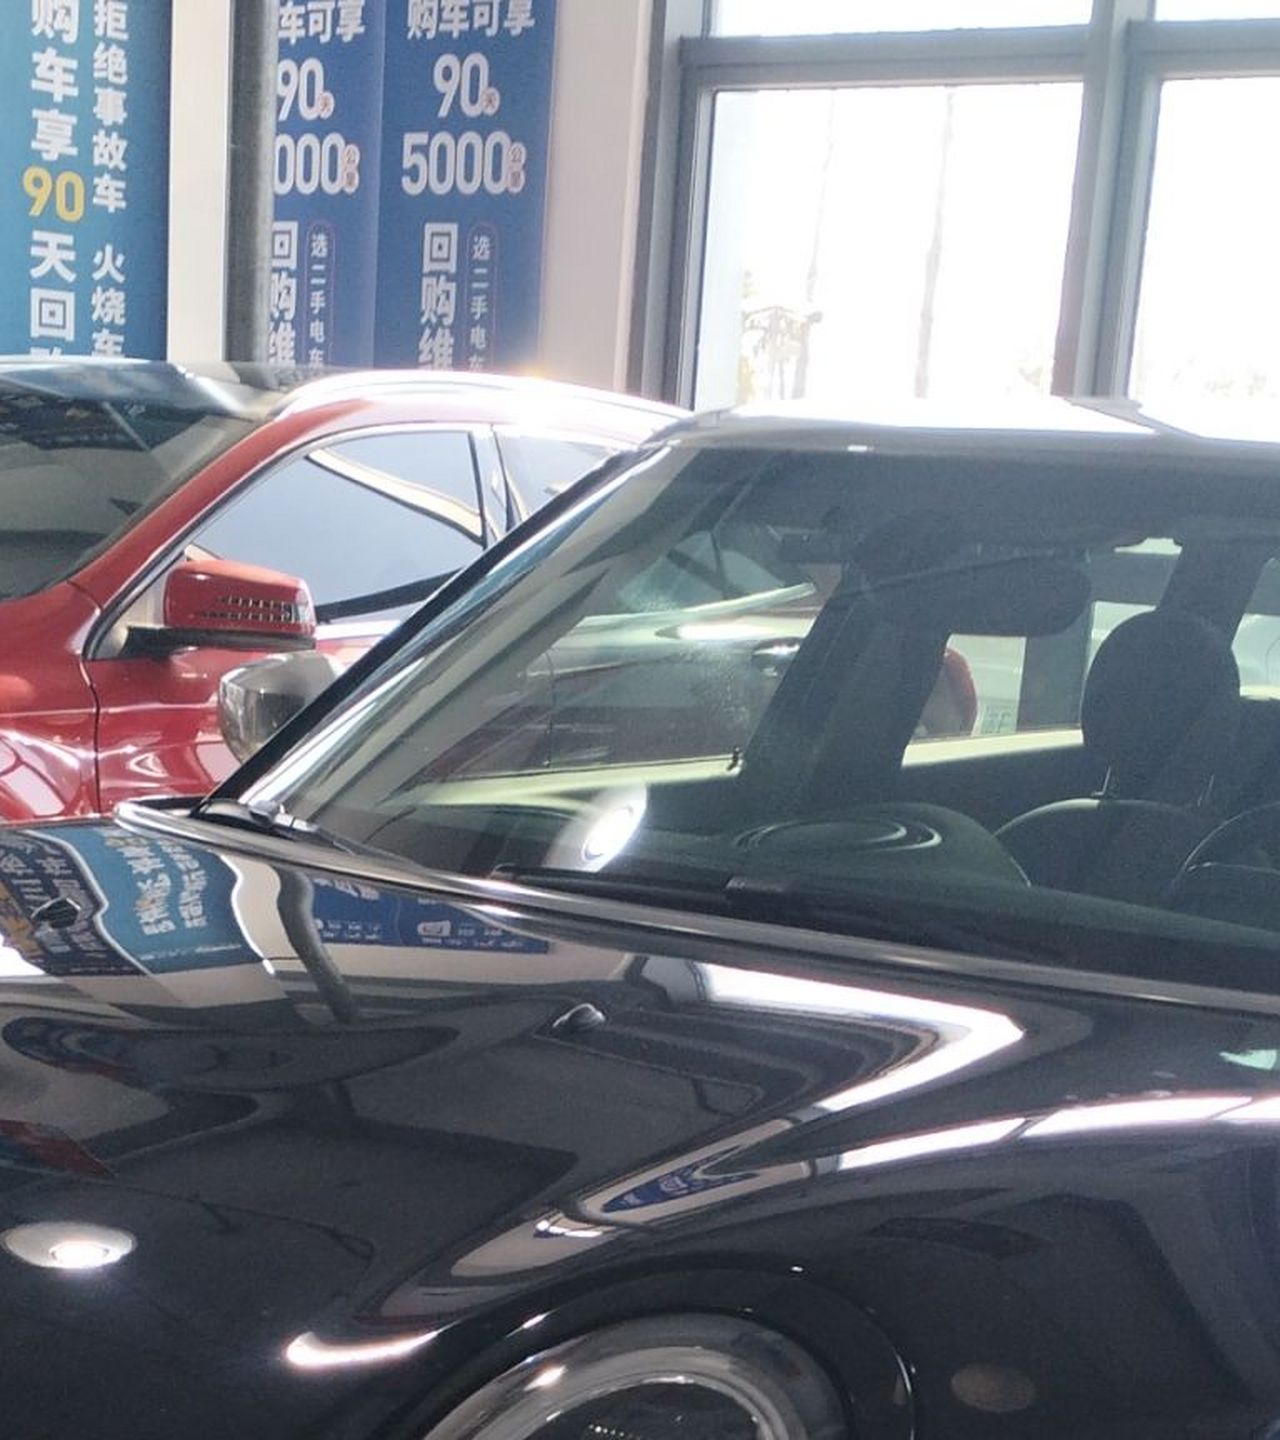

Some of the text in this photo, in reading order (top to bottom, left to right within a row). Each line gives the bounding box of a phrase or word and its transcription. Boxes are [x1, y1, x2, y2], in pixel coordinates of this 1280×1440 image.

[23, 0, 84, 360] 购车享90天回
[91, 0, 128, 358] 拒绝事故车 火烧车
